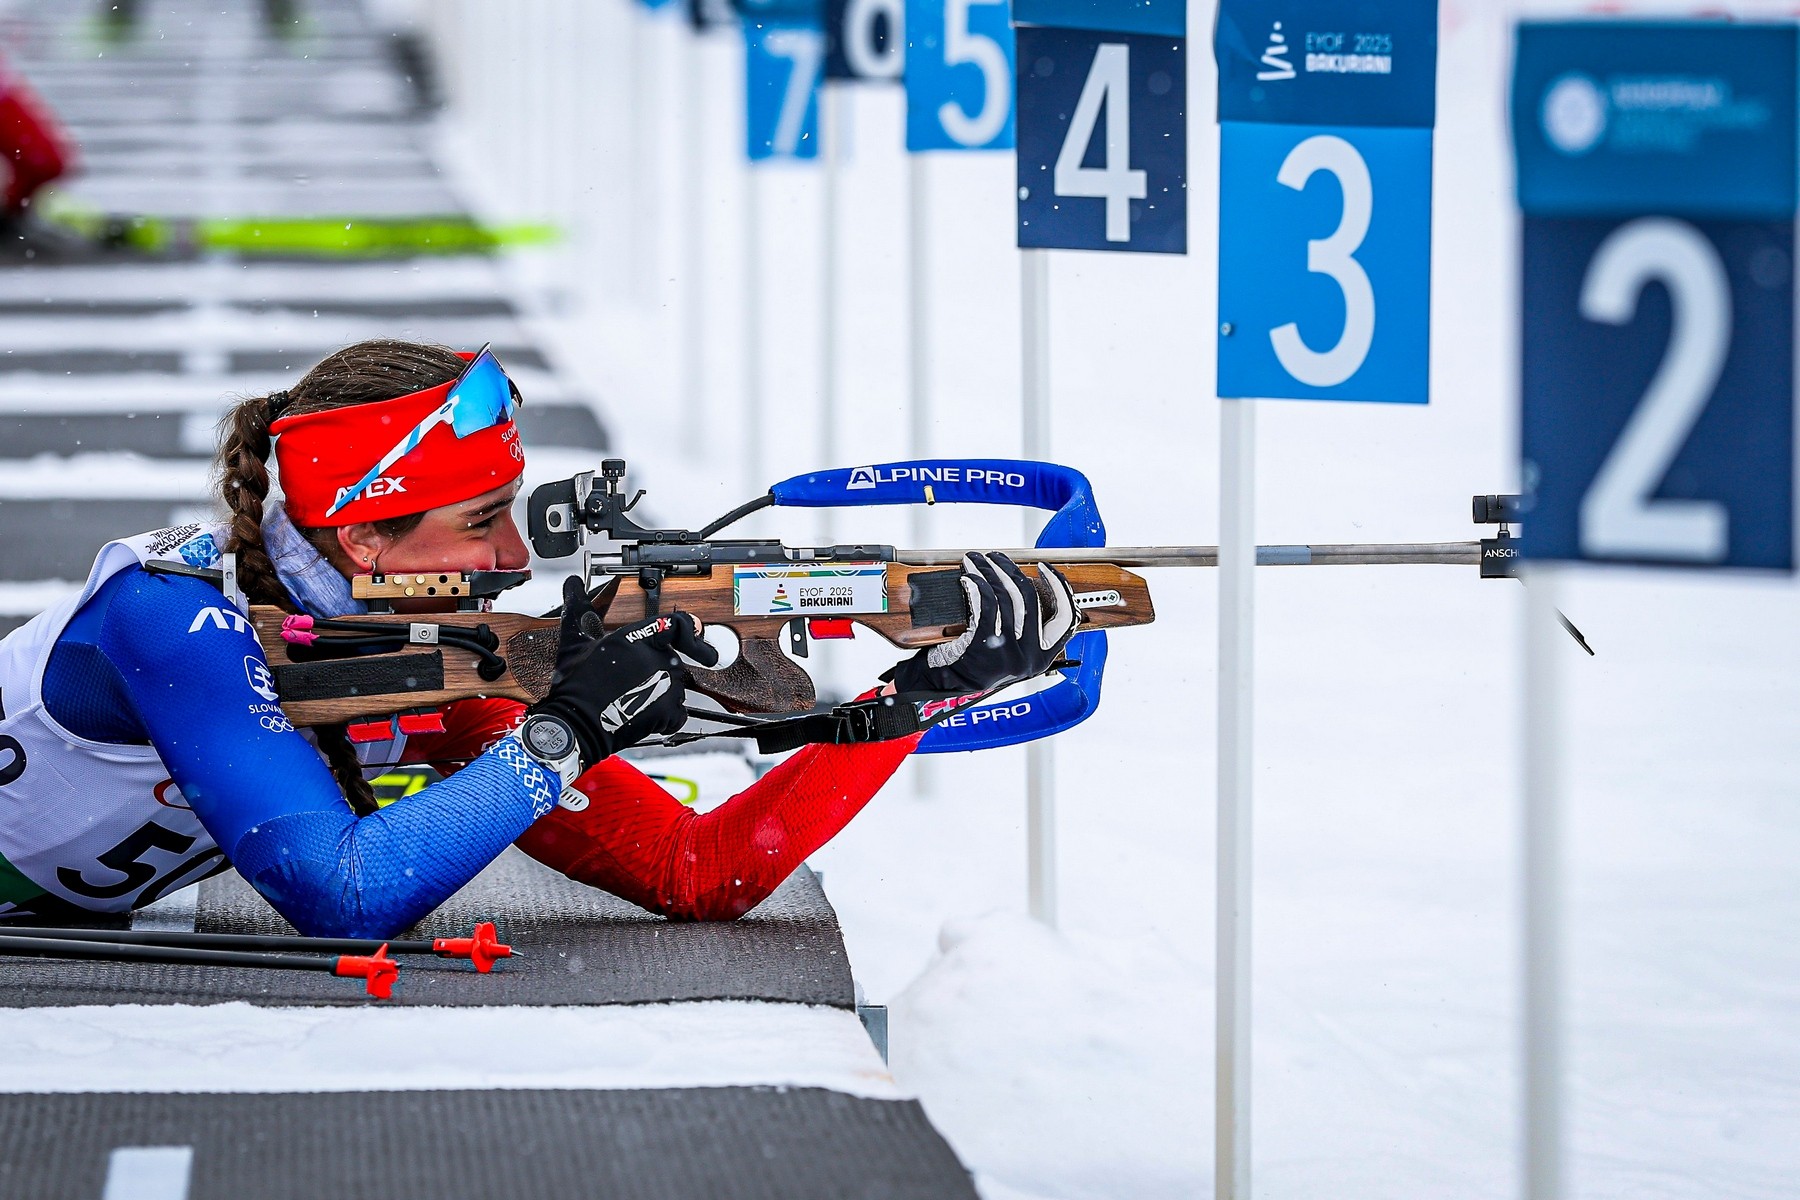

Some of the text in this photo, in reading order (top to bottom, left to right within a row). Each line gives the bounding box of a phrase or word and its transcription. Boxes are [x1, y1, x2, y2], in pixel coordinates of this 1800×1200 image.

[1304, 32, 1393, 52] EYOF 2025
[938, 0, 1011, 146] 5
[1305, 53, 1392, 74] BAKURIANI
[764, 28, 825, 154] 7
[1054, 43, 1148, 242] 4
[1270, 135, 1374, 387] 3
[1580, 218, 1730, 559] 2
[846, 466, 1025, 489] ALPINE PRO
[799, 586, 853, 597] EYOF 2025
[800, 596, 853, 607] BAKURIANI
[971, 702, 1031, 724] PRO
